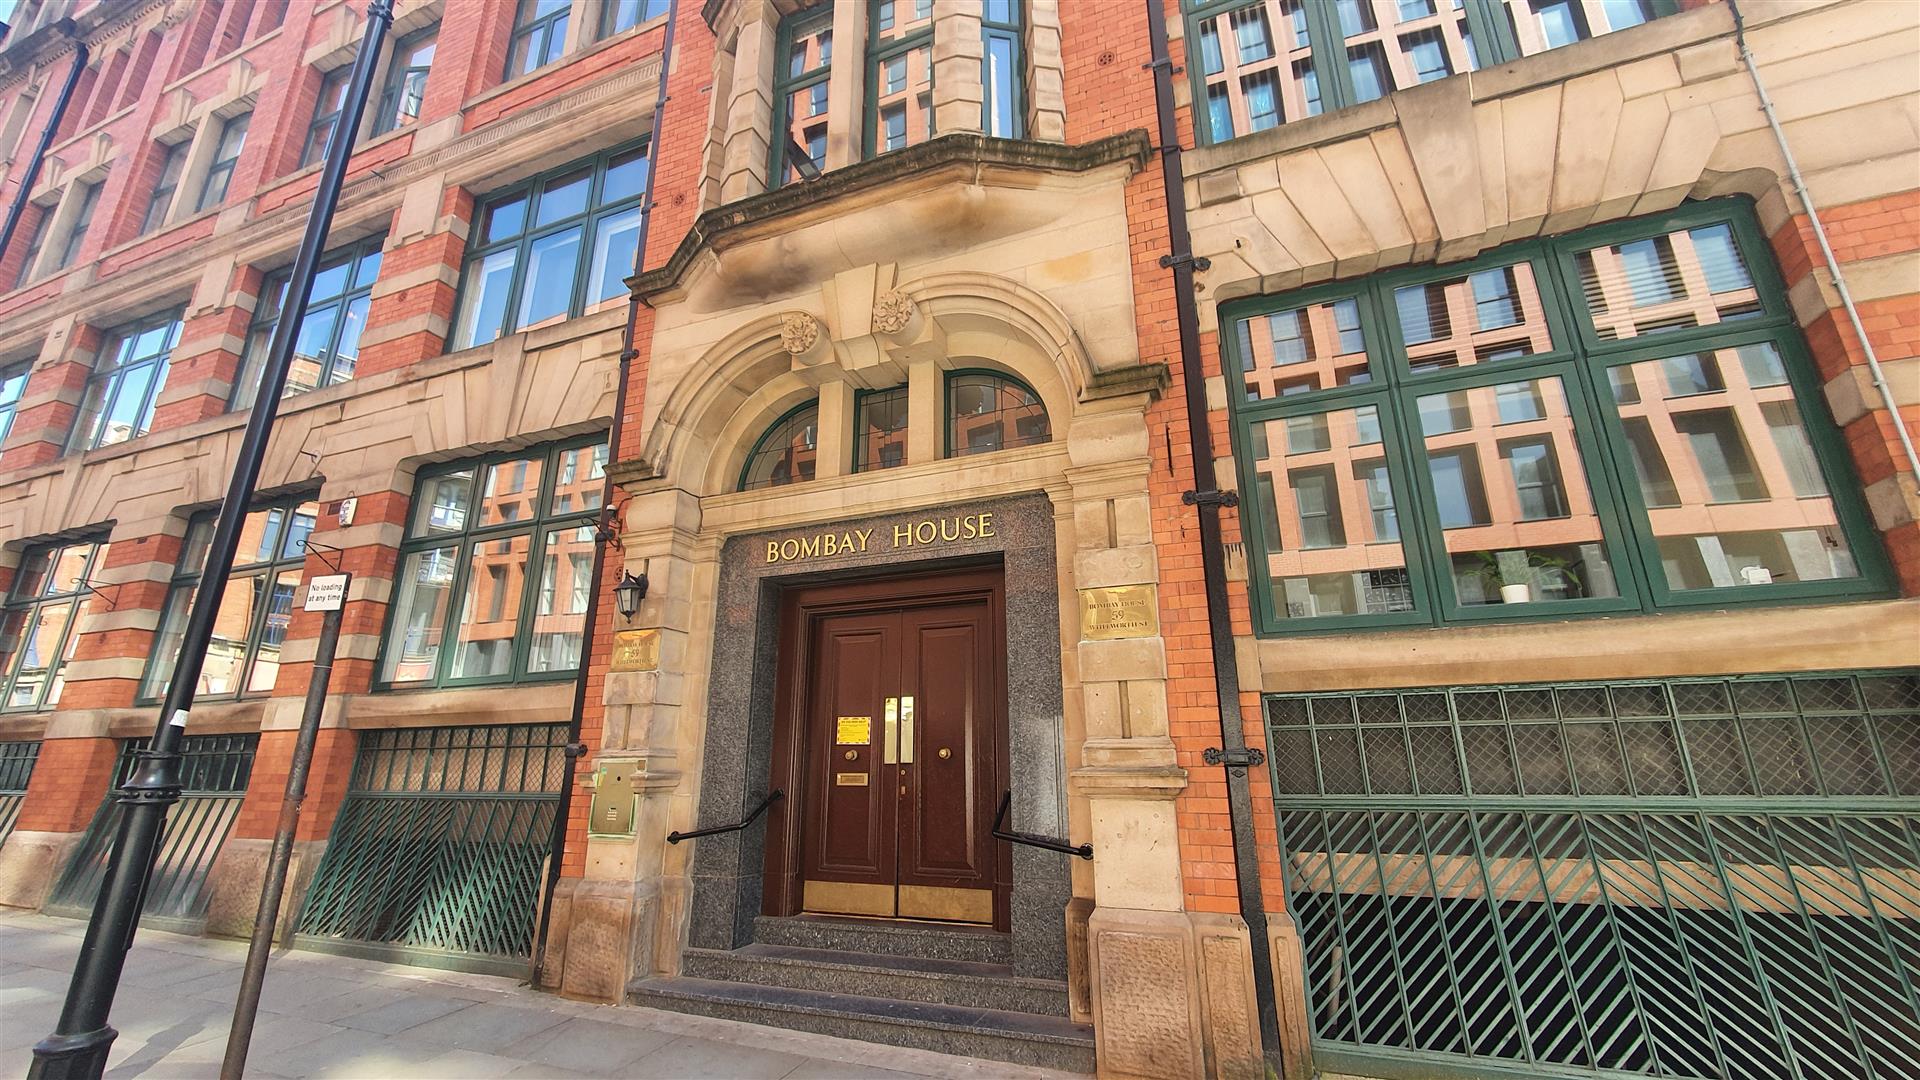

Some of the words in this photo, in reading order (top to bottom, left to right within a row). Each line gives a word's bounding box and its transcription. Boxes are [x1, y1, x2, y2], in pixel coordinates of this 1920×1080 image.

[766, 528, 873, 563] BOMBAY
[893, 513, 996, 548] HOUSE
[321, 583, 342, 591] loading
[315, 595, 326, 603] any
[327, 593, 341, 601] time
[1089, 601, 1119, 610] BOMBAY
[1111, 610, 1124, 621] 59
